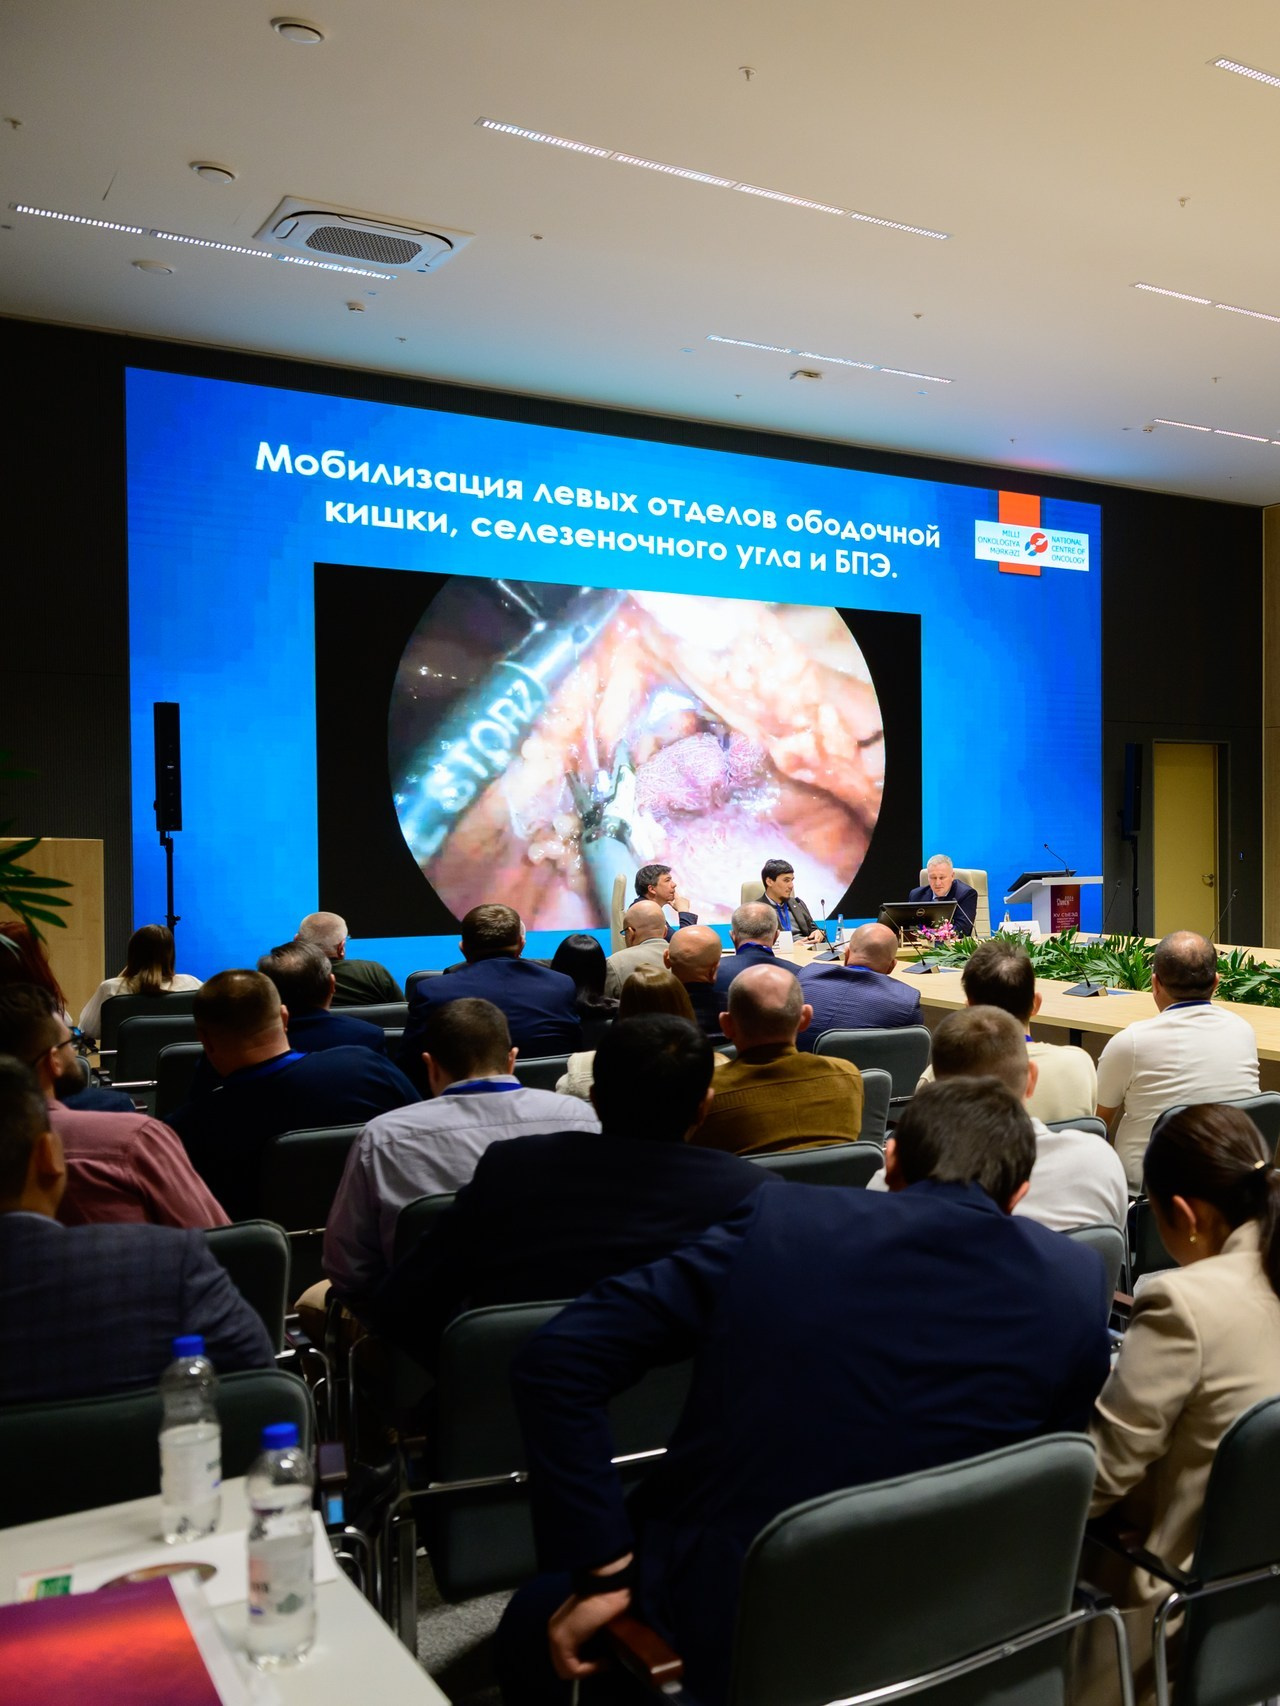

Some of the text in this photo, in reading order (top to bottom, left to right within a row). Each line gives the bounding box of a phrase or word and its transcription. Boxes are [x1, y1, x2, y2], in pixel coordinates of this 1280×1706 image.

[255, 441, 940, 548] Мобилизация левых отделов ободочной
[325, 500, 898, 579] кишки, селезеночного угла и БПЭ.
[1052, 536, 1082, 546] NATIONAL
[1052, 545, 1075, 554] CENTRE
[1052, 554, 1085, 564] ONCOLOGY
